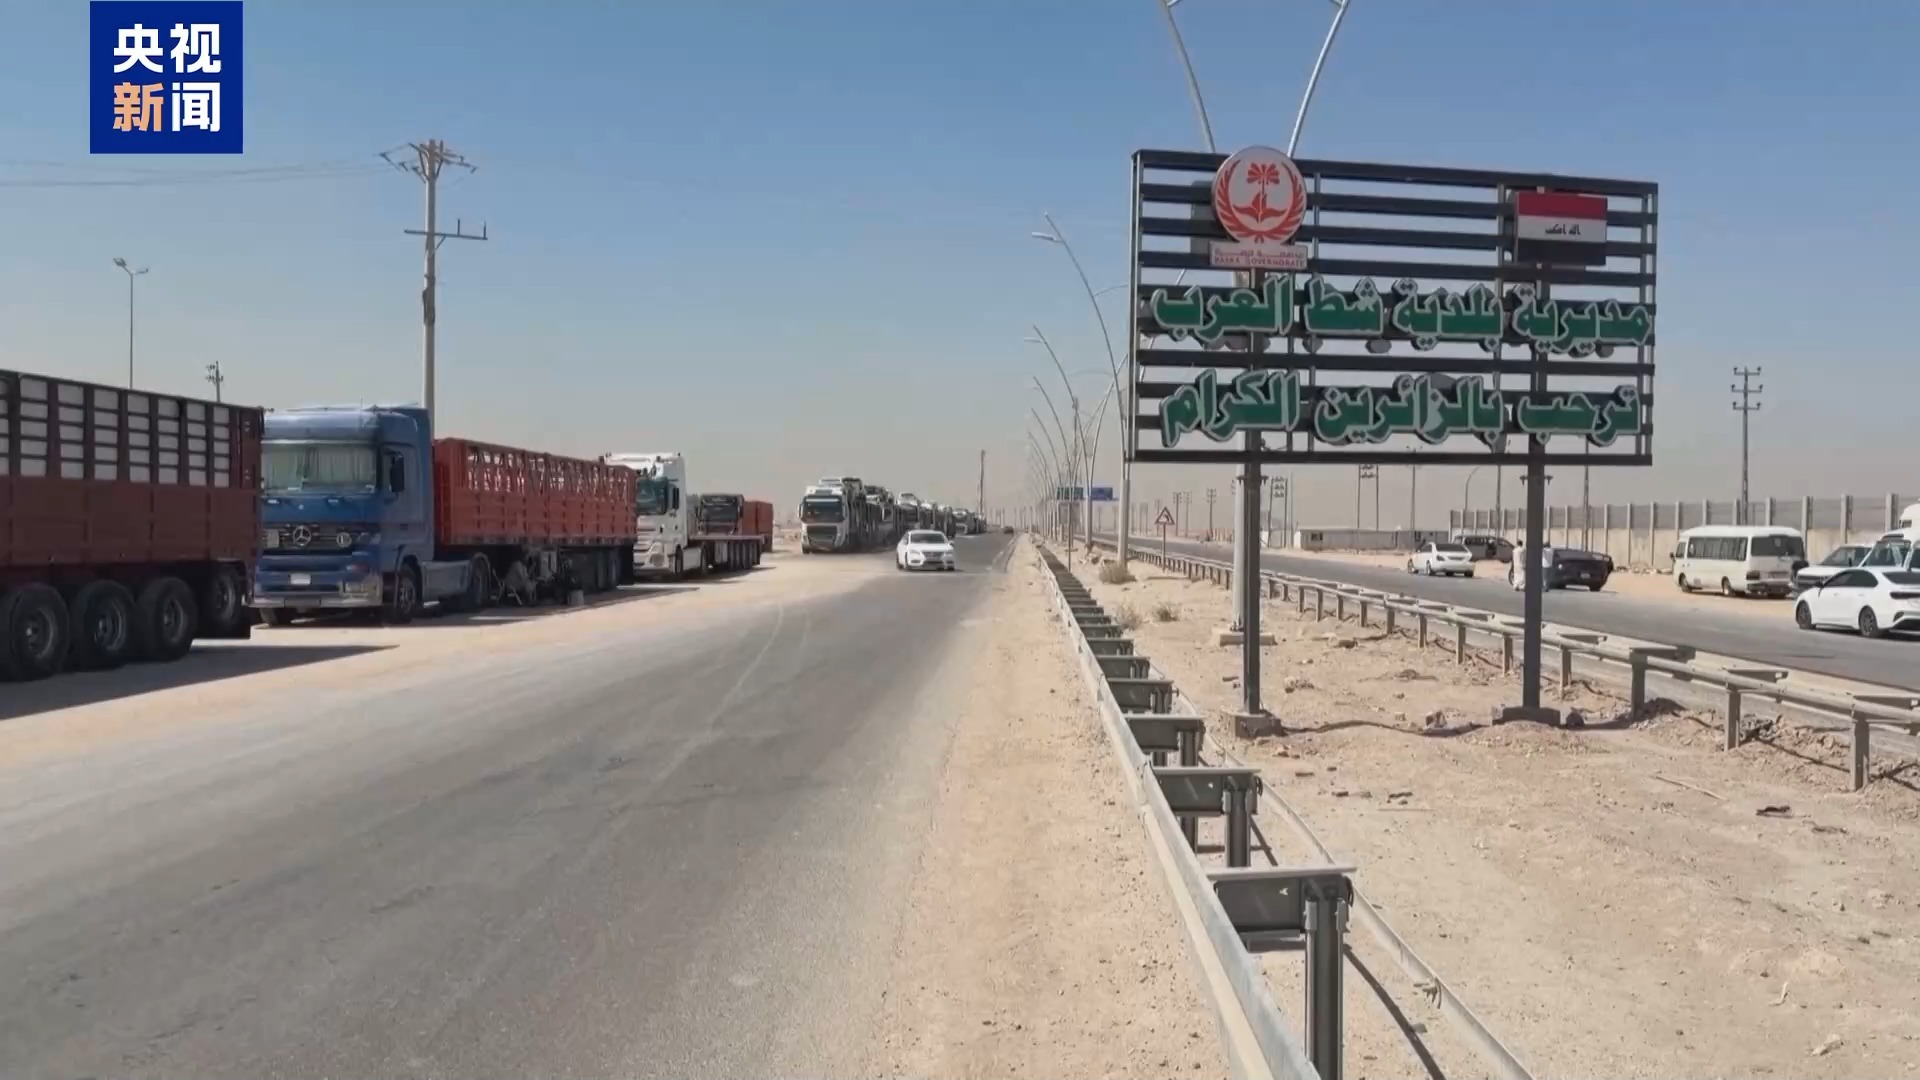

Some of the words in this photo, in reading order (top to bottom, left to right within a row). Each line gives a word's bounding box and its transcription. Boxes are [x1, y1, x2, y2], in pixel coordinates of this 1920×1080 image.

[1151, 275, 1294, 343] العرب
[1303, 275, 1384, 335] شط
[1392, 279, 1503, 351] بلدية
[1512, 284, 1651, 352] مديرية
[1160, 368, 1300, 448] الكرام
[1314, 374, 1503, 443] بالزائرين
[1517, 385, 1641, 446] ترحب
